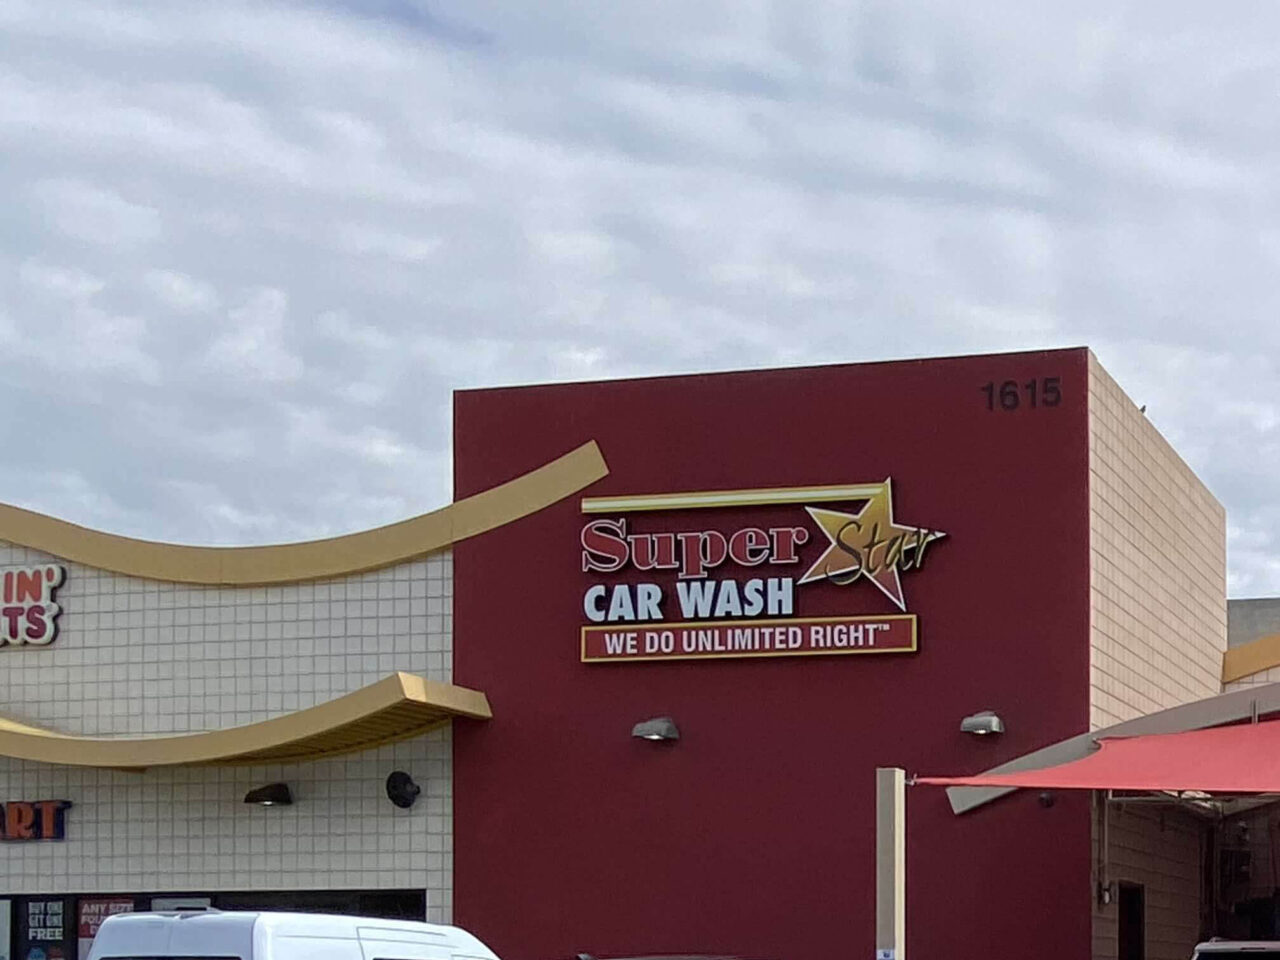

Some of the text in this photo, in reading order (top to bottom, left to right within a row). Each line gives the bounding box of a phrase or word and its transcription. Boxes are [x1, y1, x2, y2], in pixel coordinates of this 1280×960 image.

[981, 378, 1062, 411] 1615
[581, 518, 930, 585] Super Star
[584, 577, 794, 622] CAR WASH
[604, 632, 638, 655] WE
[644, 630, 675, 653] DO
[682, 626, 803, 653] UNLIMITED
[82, 903, 107, 915] ANY
[28, 927, 64, 940] FREE
